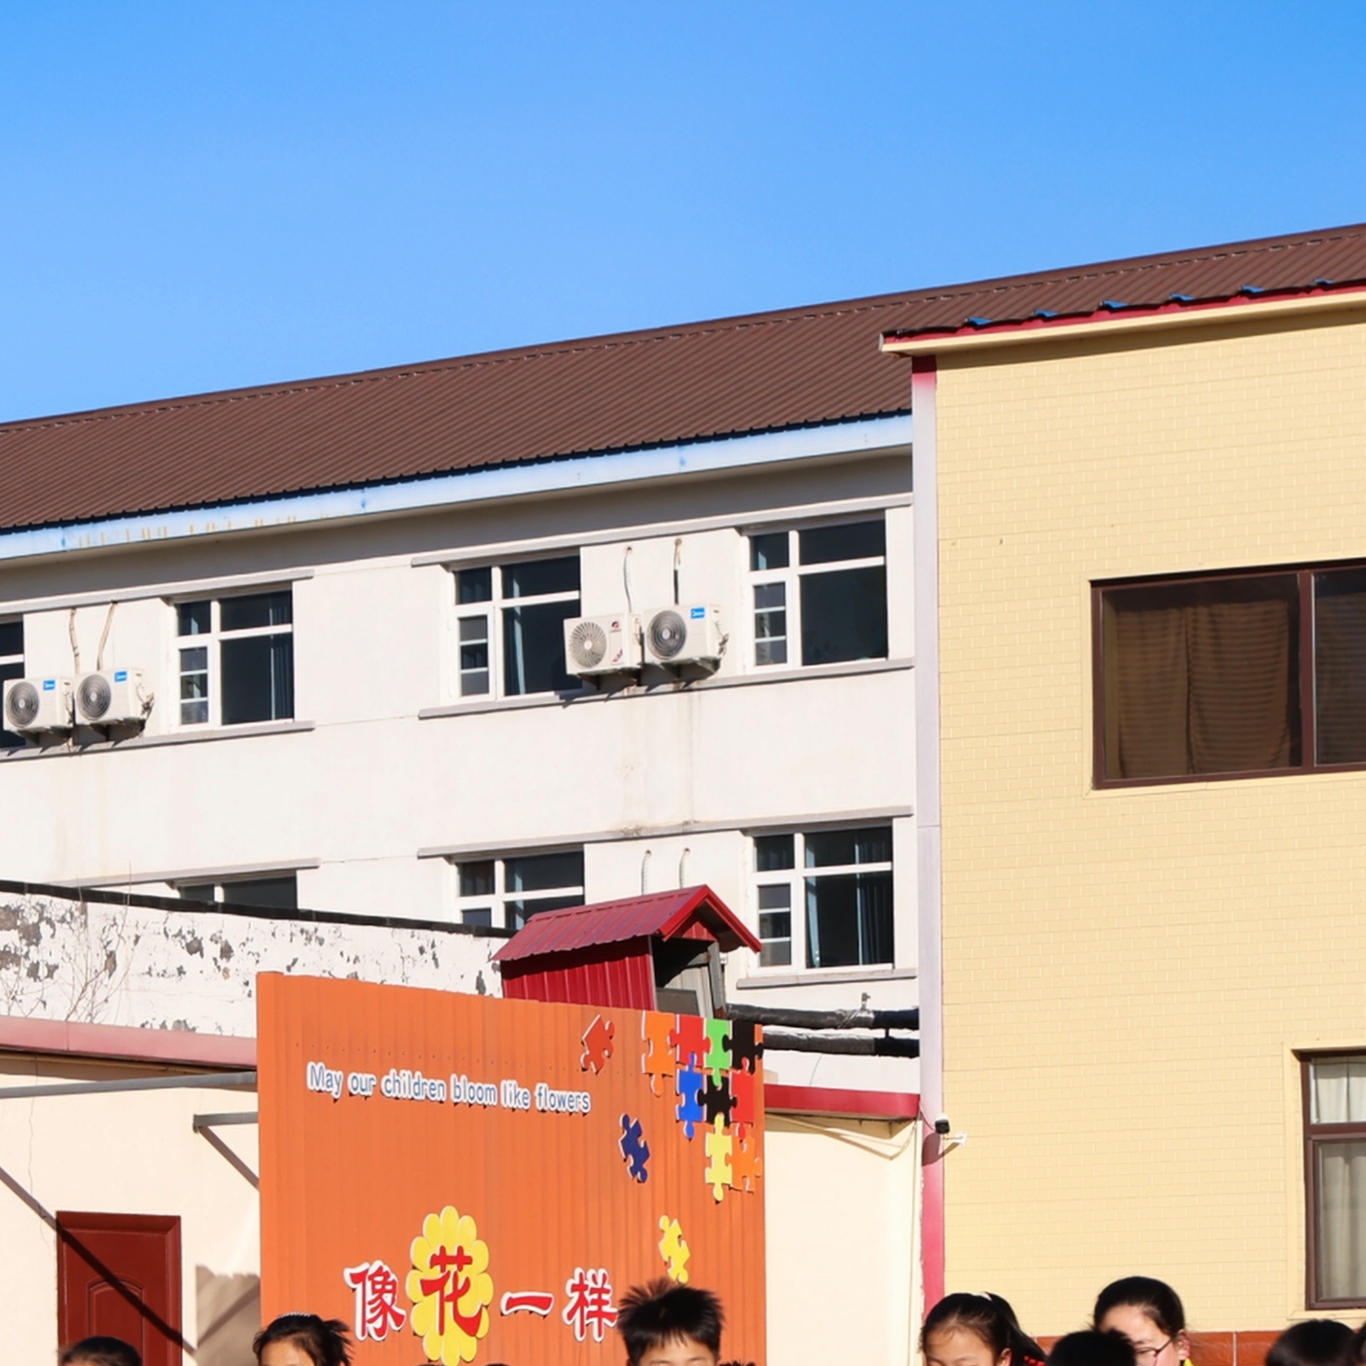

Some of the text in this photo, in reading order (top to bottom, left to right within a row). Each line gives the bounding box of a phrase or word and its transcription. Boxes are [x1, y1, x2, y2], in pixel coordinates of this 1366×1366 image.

[307, 1061, 591, 1113] May our children bloom like flowers
[343, 1245, 618, 1342] 像花一样
